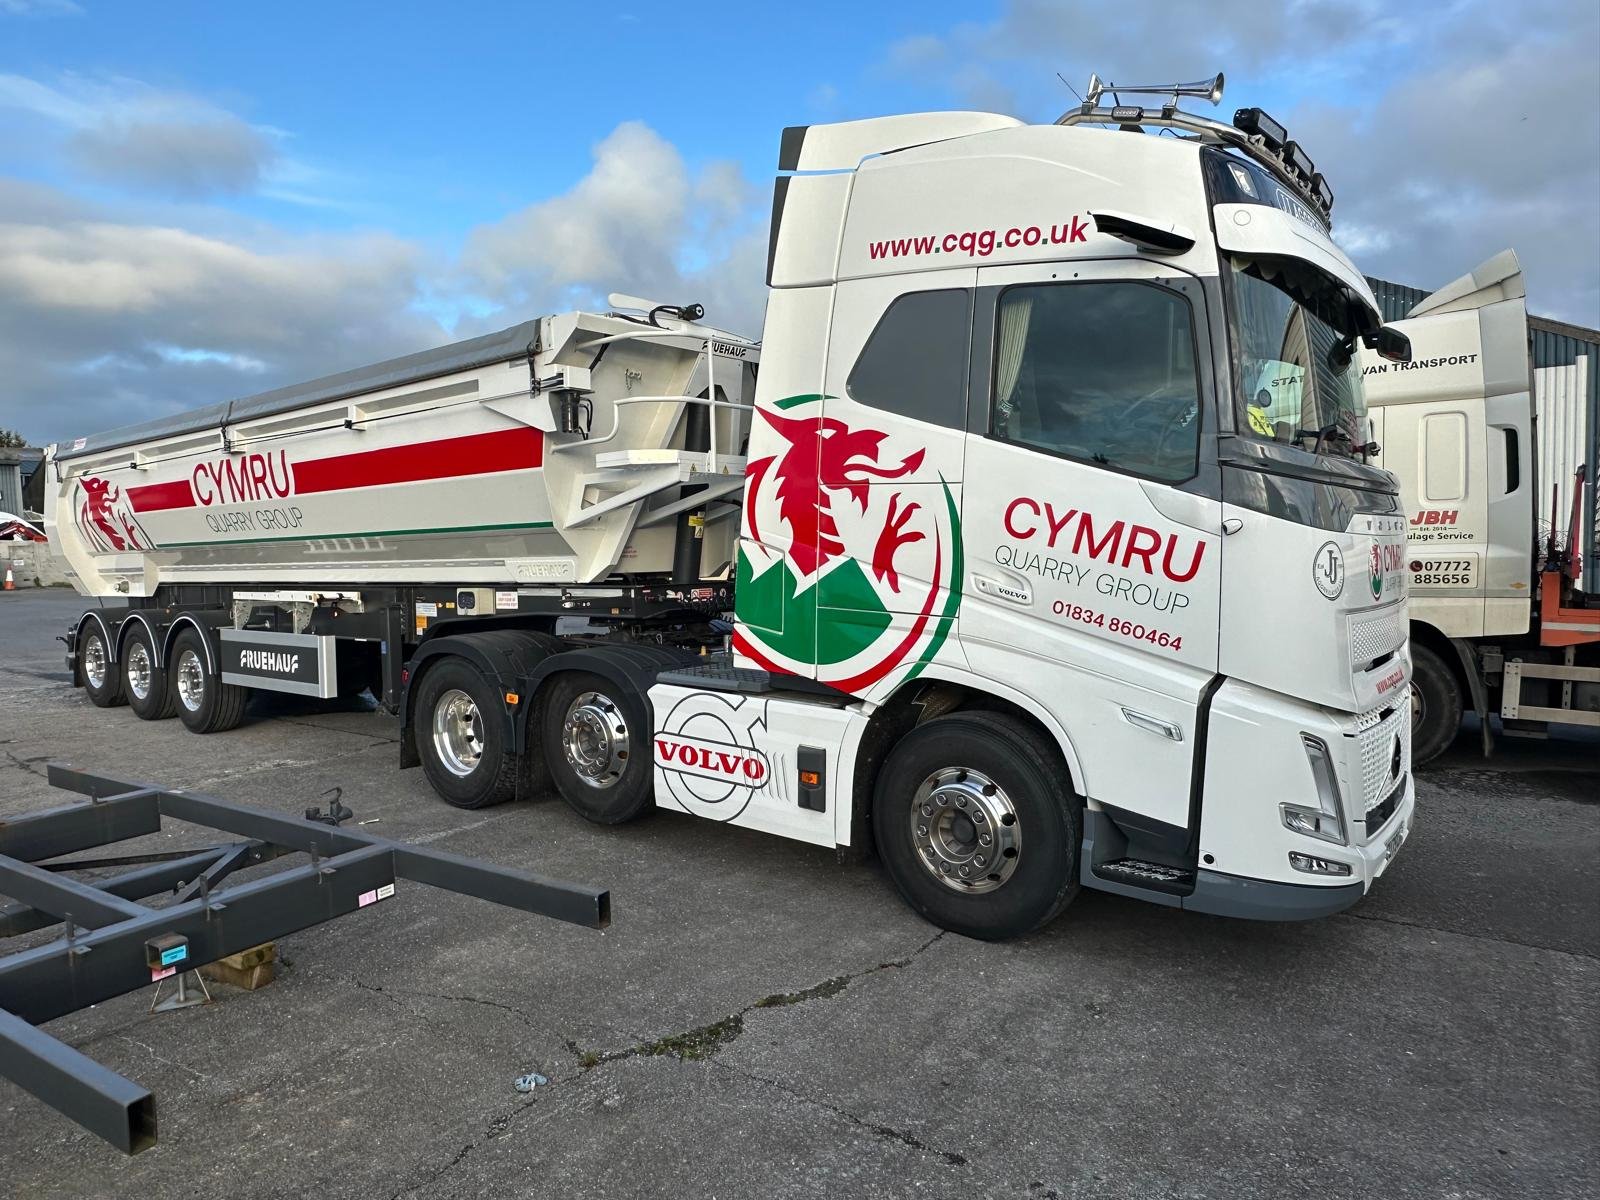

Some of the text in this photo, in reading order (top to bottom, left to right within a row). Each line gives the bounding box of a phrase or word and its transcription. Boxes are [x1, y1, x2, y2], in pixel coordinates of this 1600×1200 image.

[869, 215, 1089, 259] www.cqg.co.uk
[701, 340, 747, 357] FUEHAUF
[1392, 354, 1478, 371] TRANSPORT
[193, 449, 290, 506] CYMRU
[205, 506, 303, 533] QUARRY GROUP
[1409, 510, 1459, 525] JBH
[1004, 497, 1207, 583] CYMRU
[1437, 531, 1474, 540] Service
[1414, 573, 1470, 584] 885656
[1424, 561, 1471, 572] 07772
[995, 545, 1190, 614] QUARRY GROUP
[998, 587, 1027, 600] VOLVO
[1052, 600, 1182, 651] 01834 860464
[240, 649, 299, 674] FRUEHAUF
[654, 739, 765, 780] VOLVO
